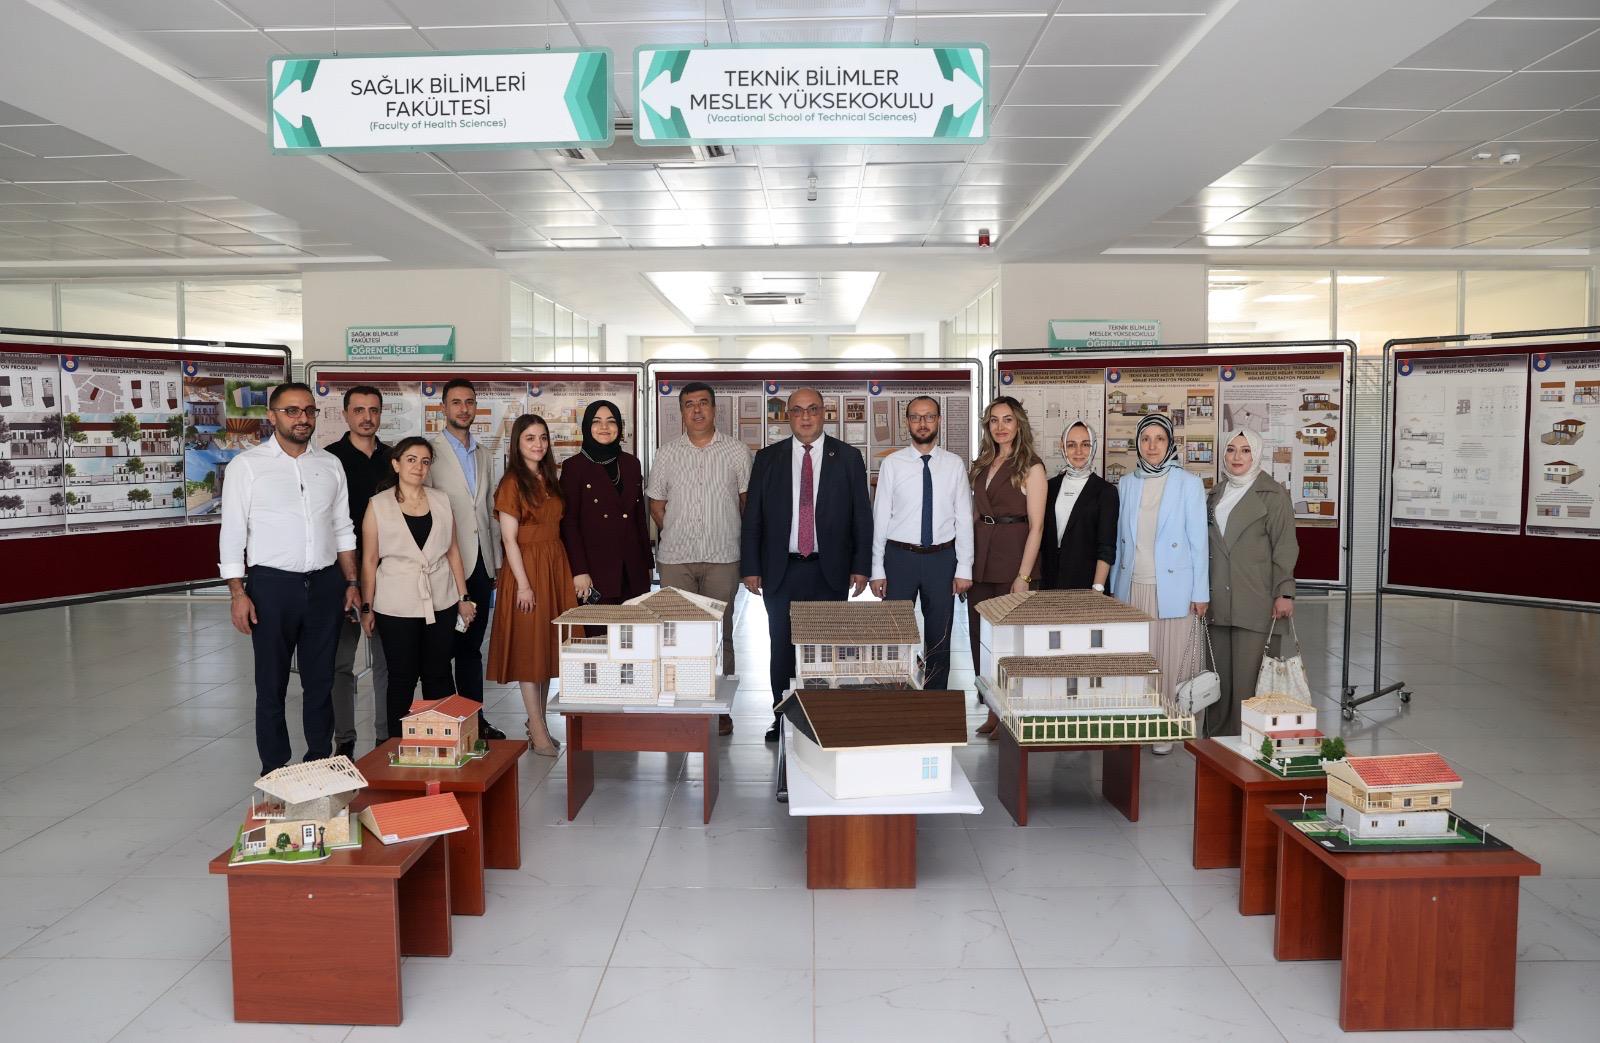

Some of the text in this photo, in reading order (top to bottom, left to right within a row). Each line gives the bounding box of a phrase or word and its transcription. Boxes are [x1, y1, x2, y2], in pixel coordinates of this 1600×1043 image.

[350, 71, 525, 95] SAĞLIK BİLİMLERİ
[725, 66, 899, 86] TEKNİK BİLİMLER
[387, 96, 490, 117] FAKÜLTESİ
[691, 89, 933, 110] MESLEK YÜKSEKOKULU
[369, 118, 507, 132] (Faculty of Health Sciences)
[707, 112, 917, 124] (Vocational School of Technical Sciences)
[351, 344, 419, 356] ÖĞRENCİ İŞLERİ
